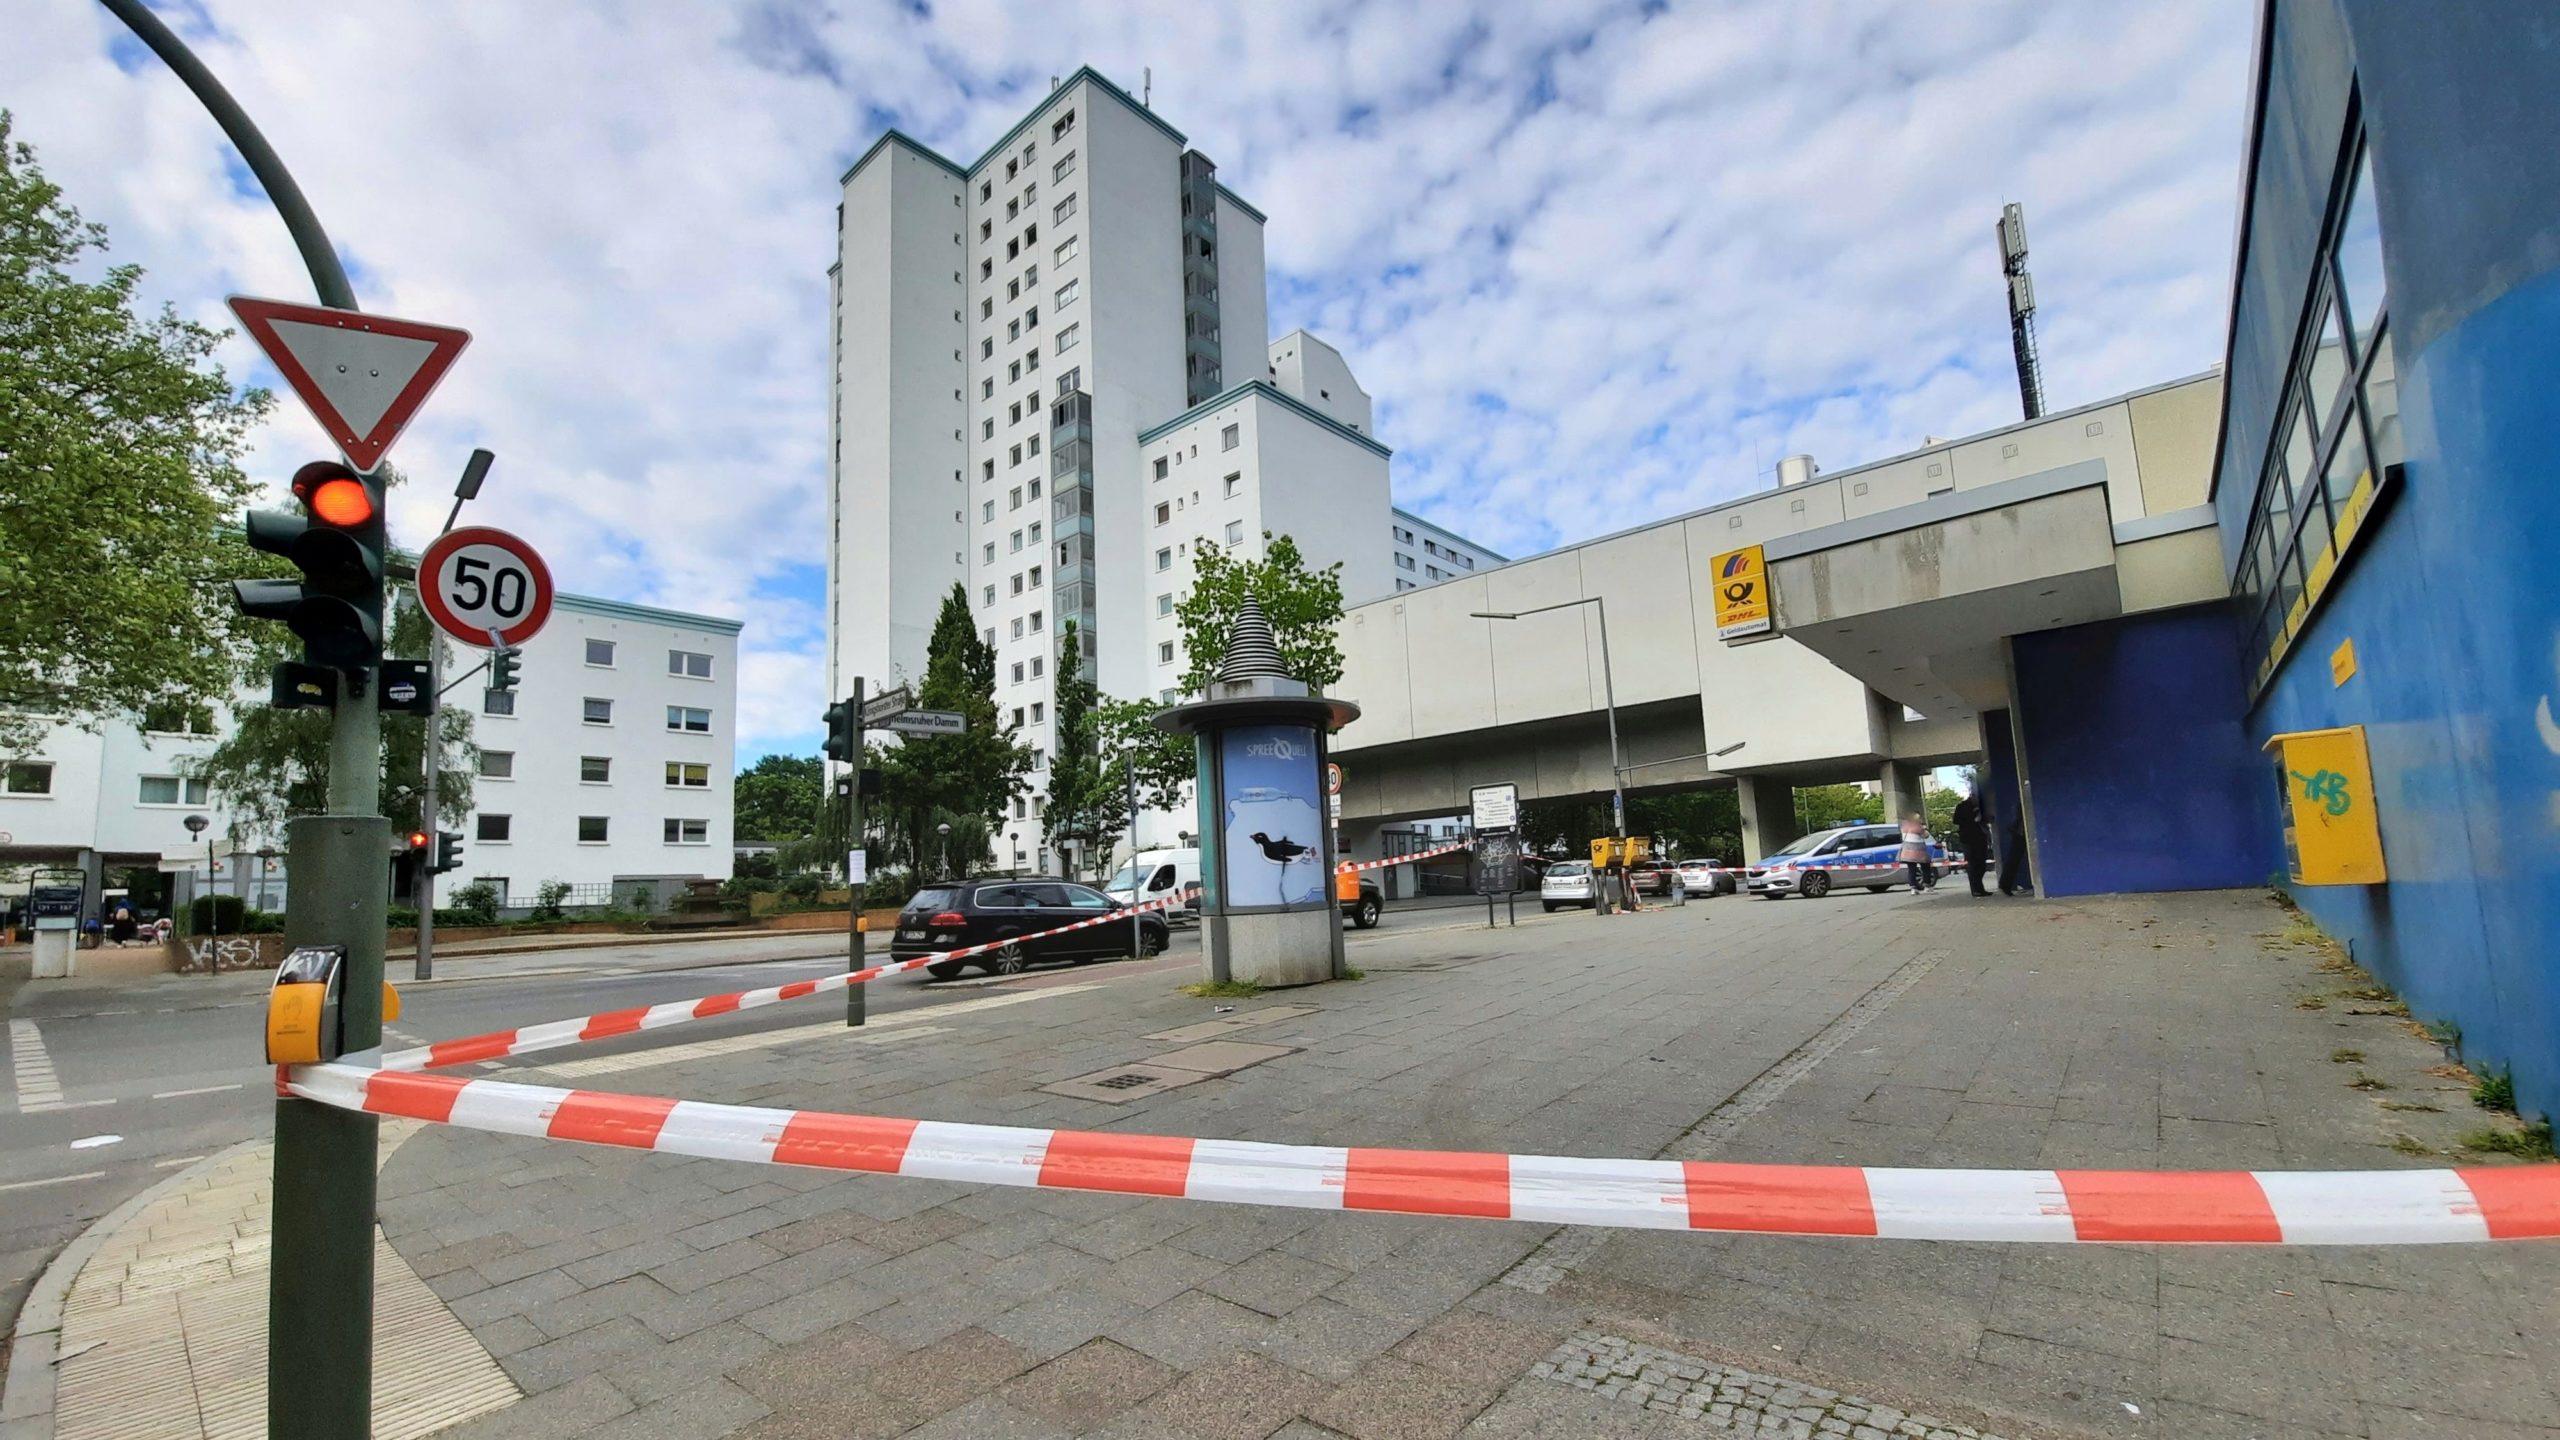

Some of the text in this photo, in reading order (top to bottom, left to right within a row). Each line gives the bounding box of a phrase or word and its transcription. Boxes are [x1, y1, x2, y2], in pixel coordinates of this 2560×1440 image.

[452, 556, 527, 619] 50
[1728, 610, 1756, 622] DHL
[1727, 621, 1767, 635] Geldautomat
[935, 716, 959, 727] Damm
[1834, 856, 1864, 866] POLIZEI
